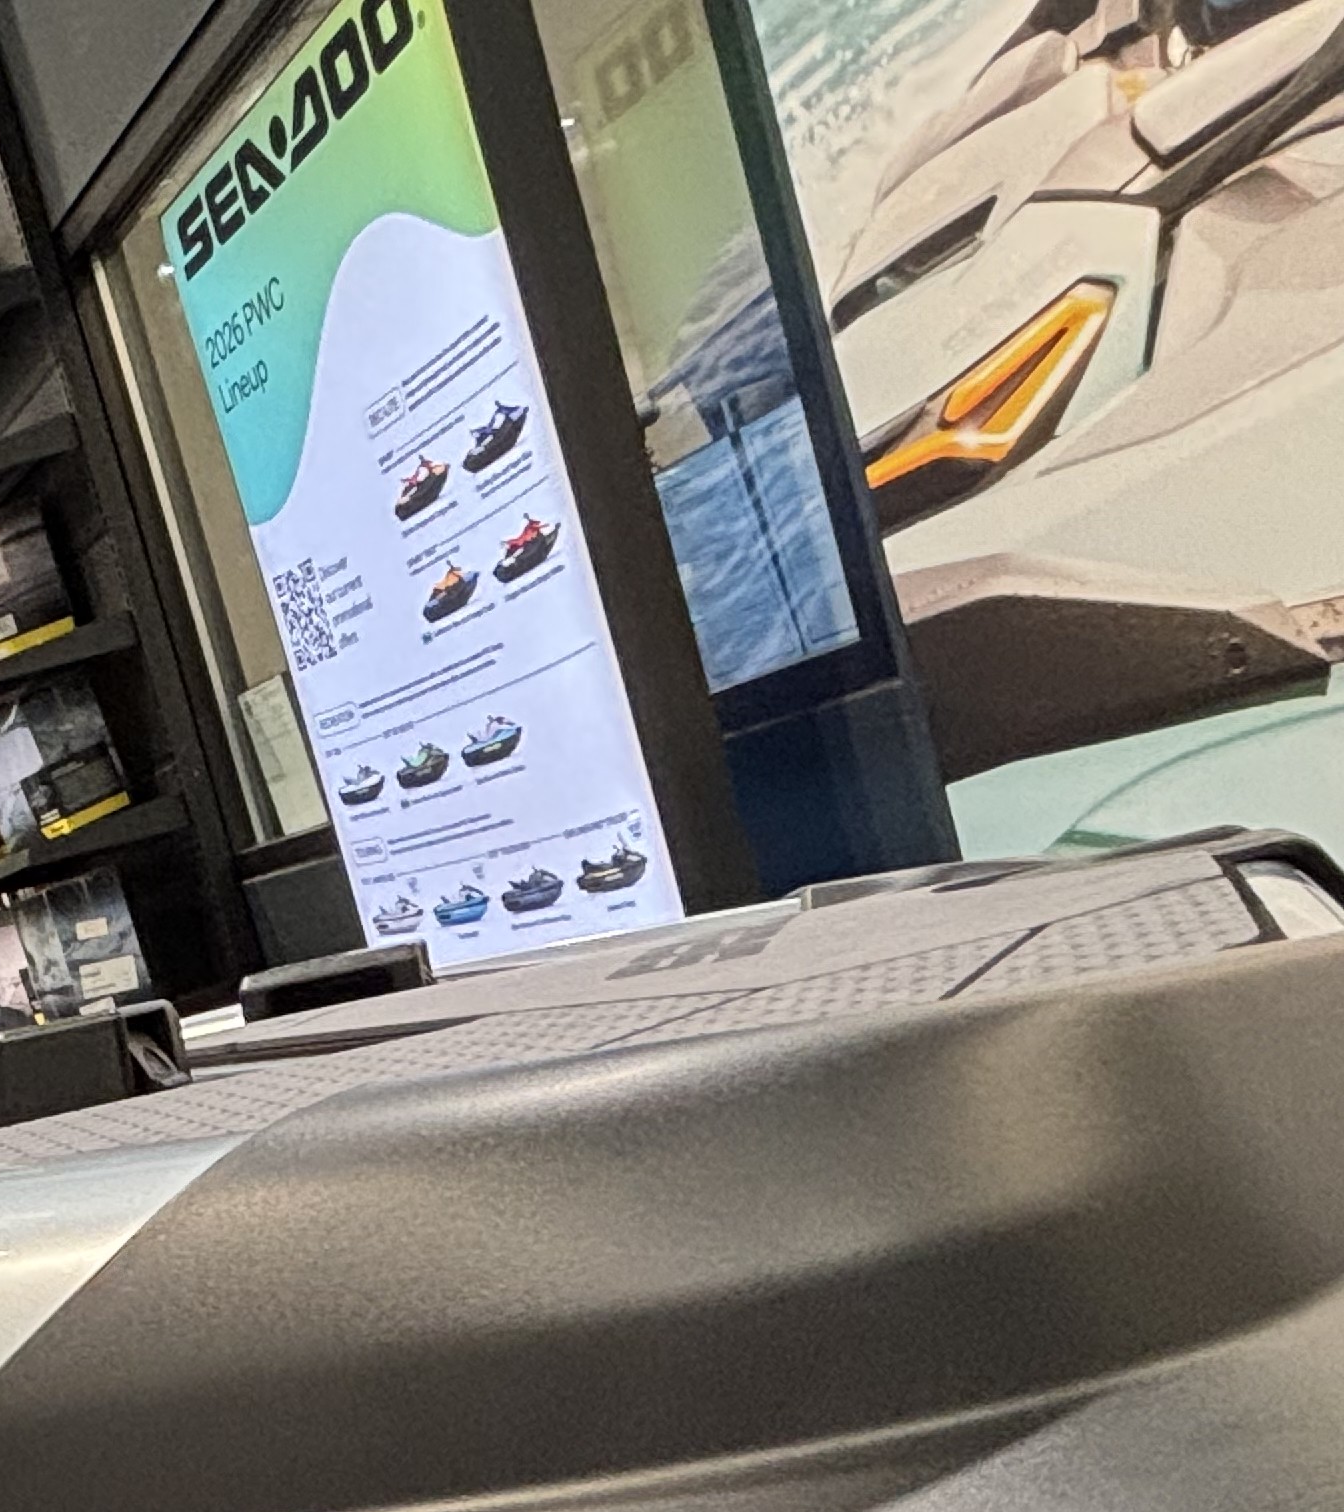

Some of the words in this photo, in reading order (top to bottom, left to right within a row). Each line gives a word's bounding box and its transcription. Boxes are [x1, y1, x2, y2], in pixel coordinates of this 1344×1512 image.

[205, 312, 245, 369] 2026
[242, 277, 285, 336] PWC
[218, 360, 268, 413] Lineup
